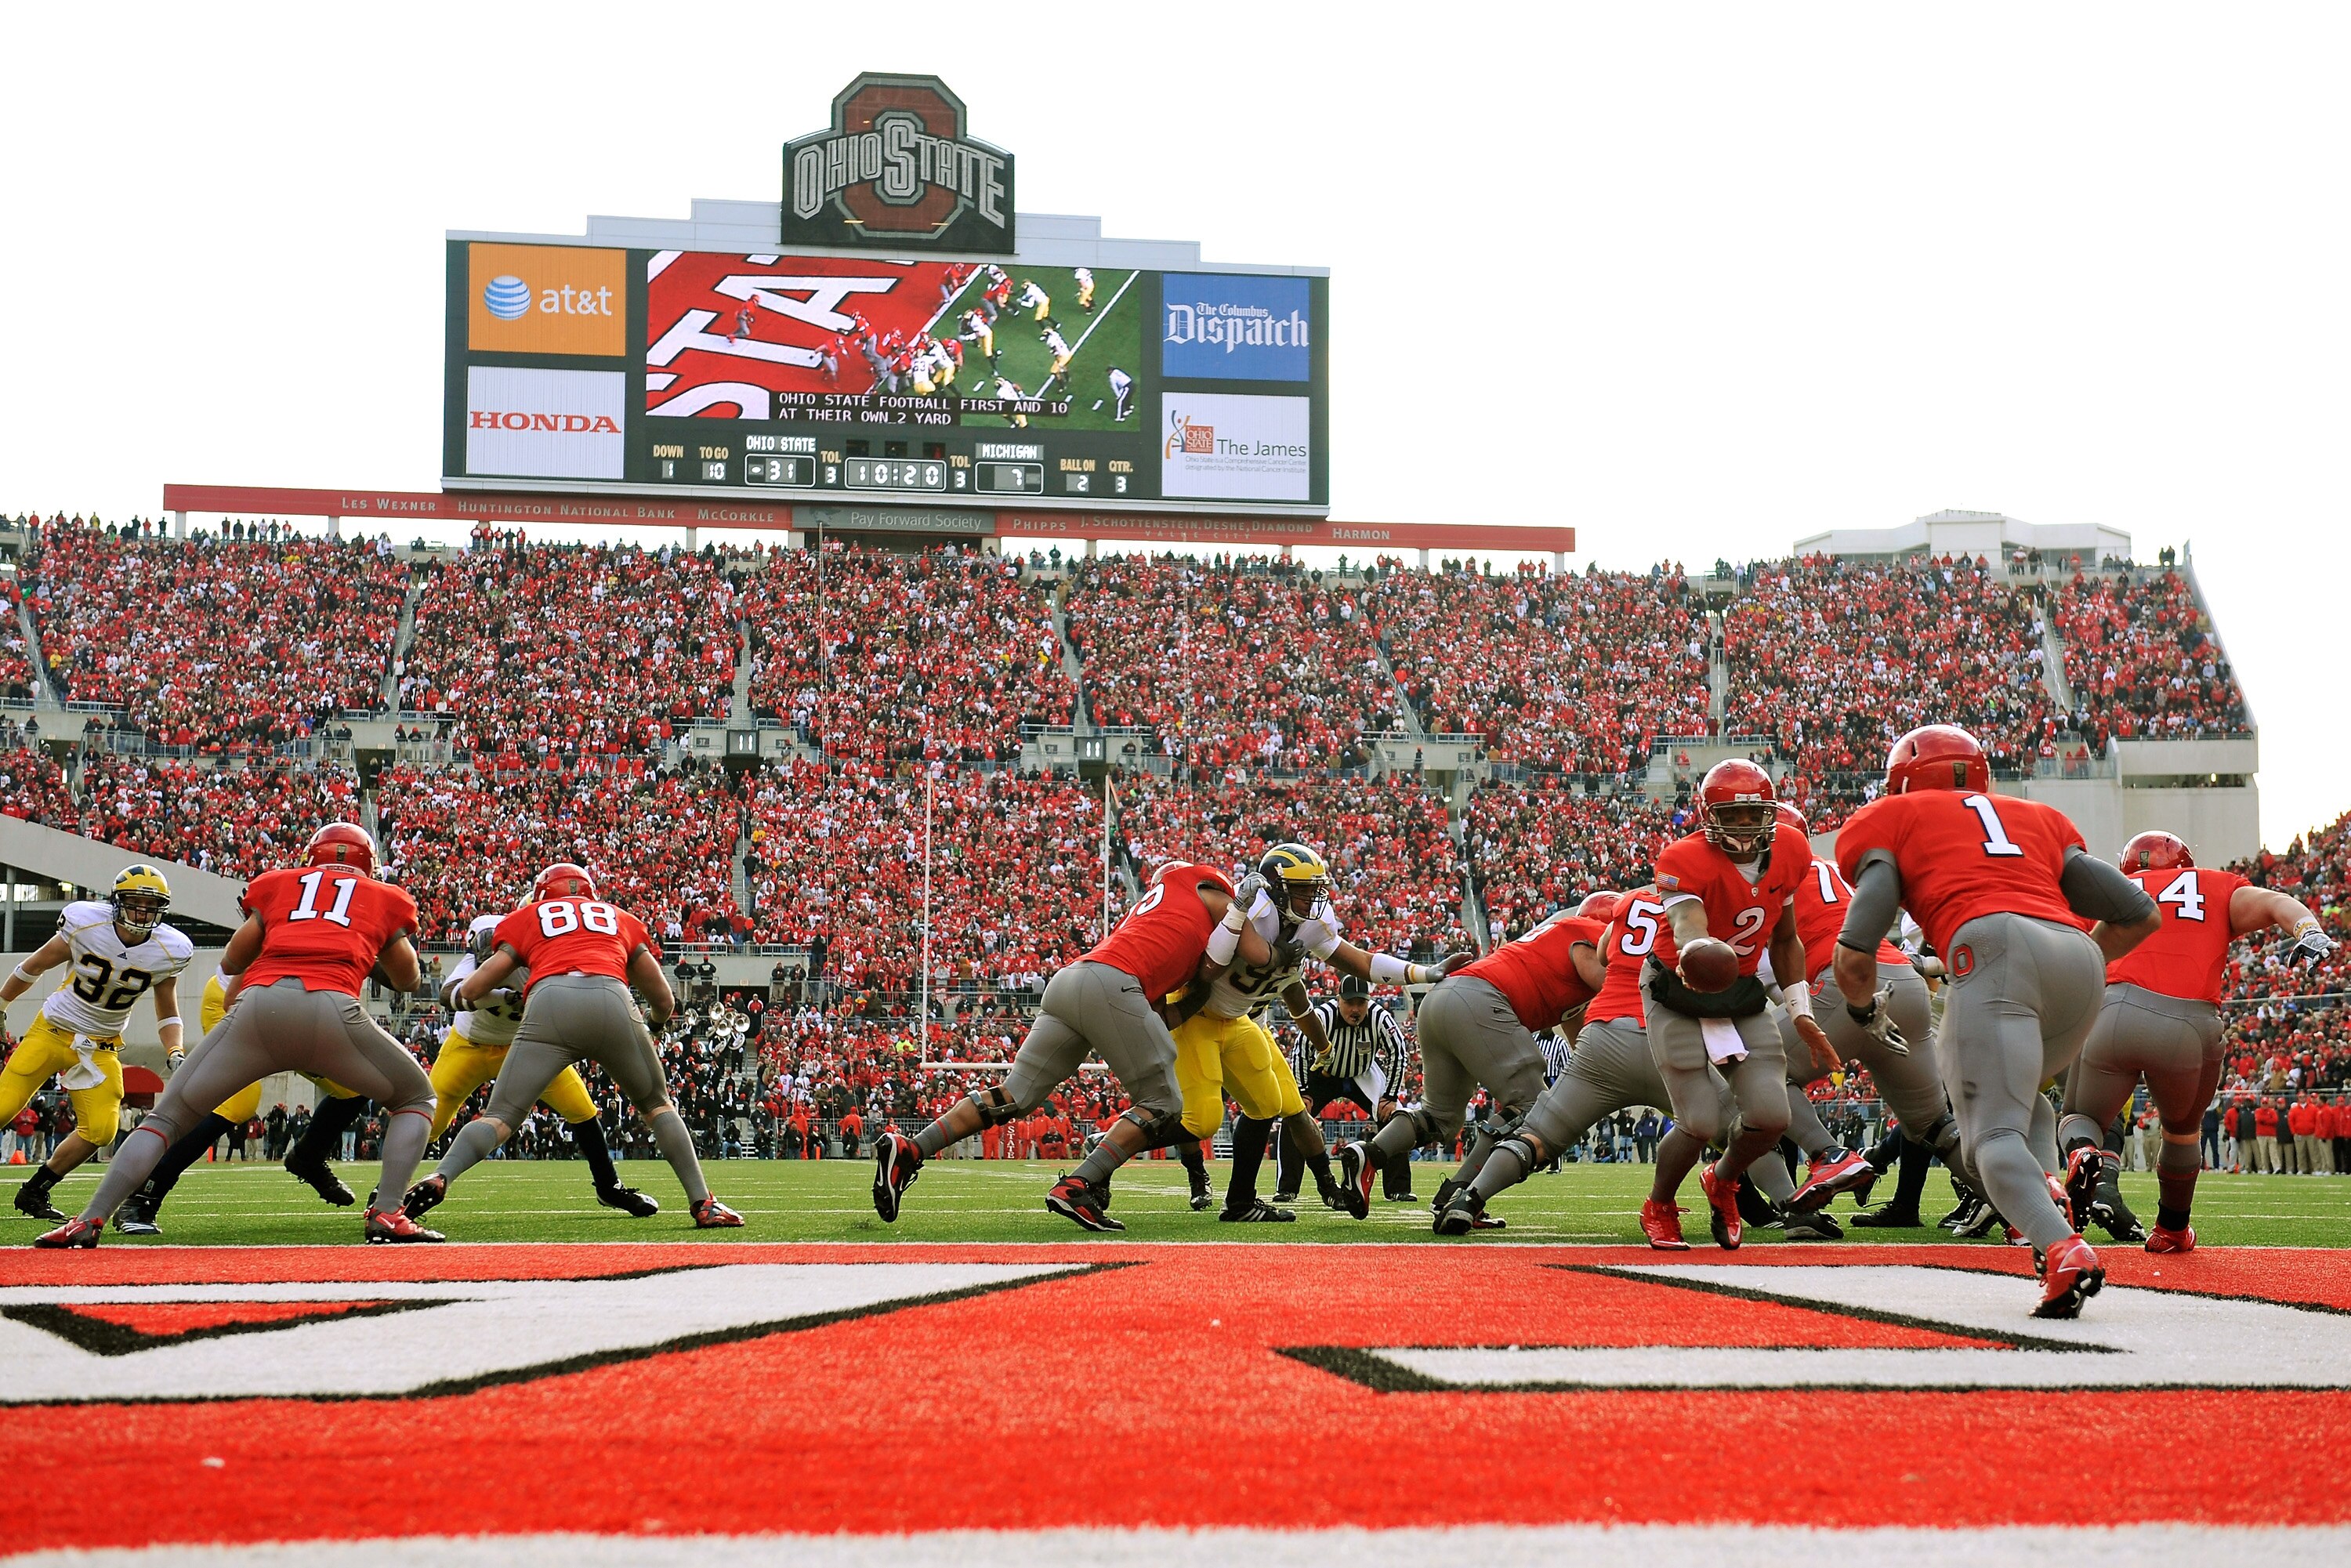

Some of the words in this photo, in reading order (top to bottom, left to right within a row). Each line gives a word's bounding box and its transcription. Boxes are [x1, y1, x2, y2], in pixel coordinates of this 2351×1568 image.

[539, 284, 612, 317] at&t
[1196, 301, 1218, 317] The
[1219, 302, 1270, 318] Columbus
[1163, 302, 1310, 354] Dispatch
[778, 393, 817, 406] OHIO
[824, 394, 871, 407] STATE
[879, 396, 951, 411] FOOTBALL
[960, 400, 1006, 412] FIRST
[1013, 401, 1041, 414] AND
[1051, 402, 1069, 415] 10
[470, 411, 622, 434] HONDA
[778, 407, 798, 420] AT
[806, 409, 853, 422] THEIR
[915, 412, 952, 425] YARD
[1186, 430, 1213, 440] OHIO
[653, 444, 684, 459] DOWN
[746, 436, 775, 451] OHIO
[781, 436, 816, 453] STATE
[982, 444, 1038, 459] MICHIGAN
[1186, 439, 1213, 449] STATE
[1216, 439, 1249, 456] The
[1253, 440, 1307, 458] James
[699, 447, 713, 460] TO
[714, 447, 730, 461] GO
[820, 451, 842, 464] TOL
[950, 455, 971, 469] TOL
[668, 463, 674, 477] 1
[708, 462, 726, 480] 10
[769, 460, 795, 481] 31
[1060, 458, 1081, 473] BALL
[1082, 459, 1096, 473] ON
[1108, 460, 1134, 473] QTR.
[827, 466, 837, 483] 3
[859, 463, 940, 486] 10:20
[955, 471, 966, 488] 3
[1011, 468, 1023, 487] 7
[1076, 475, 1089, 491] 2
[1117, 476, 1127, 493] 3
[850, 511, 875, 528] Pay
[878, 512, 931, 527] Forward
[935, 514, 982, 531] Society
[1962, 793, 2025, 857] 1
[288, 870, 358, 928] 11
[536, 900, 620, 939] 88
[1724, 904, 1766, 958] 2
[73, 953, 152, 1011] 32
